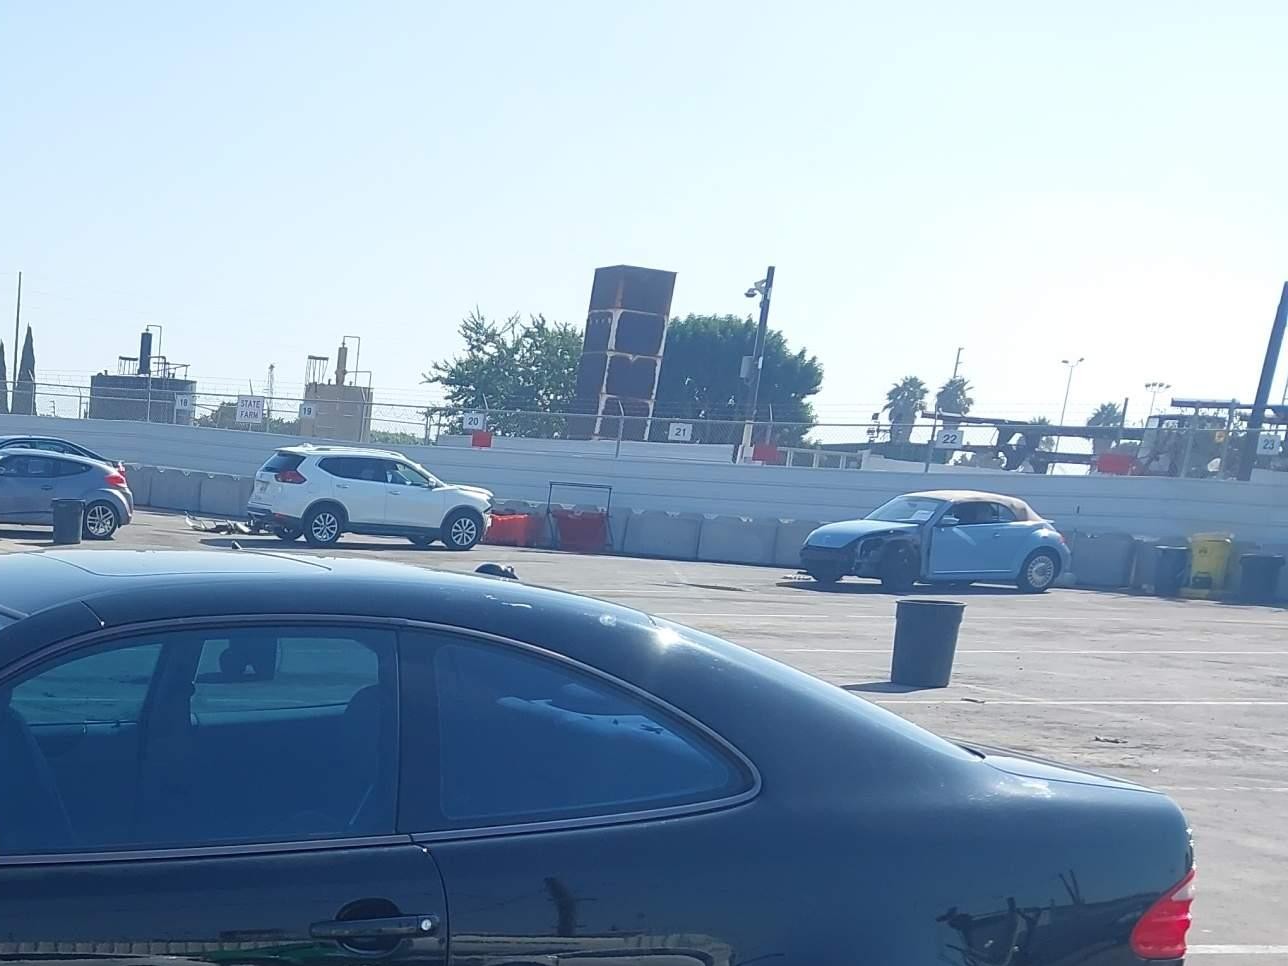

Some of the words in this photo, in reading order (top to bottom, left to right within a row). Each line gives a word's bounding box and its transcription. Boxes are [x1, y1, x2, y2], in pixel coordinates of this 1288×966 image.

[180, 398, 188, 407] 18
[240, 399, 261, 408] STATE
[240, 410, 259, 418] FARM
[303, 407, 312, 416] 19
[468, 416, 479, 426] 20
[675, 427, 686, 436] 21
[943, 434, 957, 444] 22
[1263, 438, 1275, 450] 23
